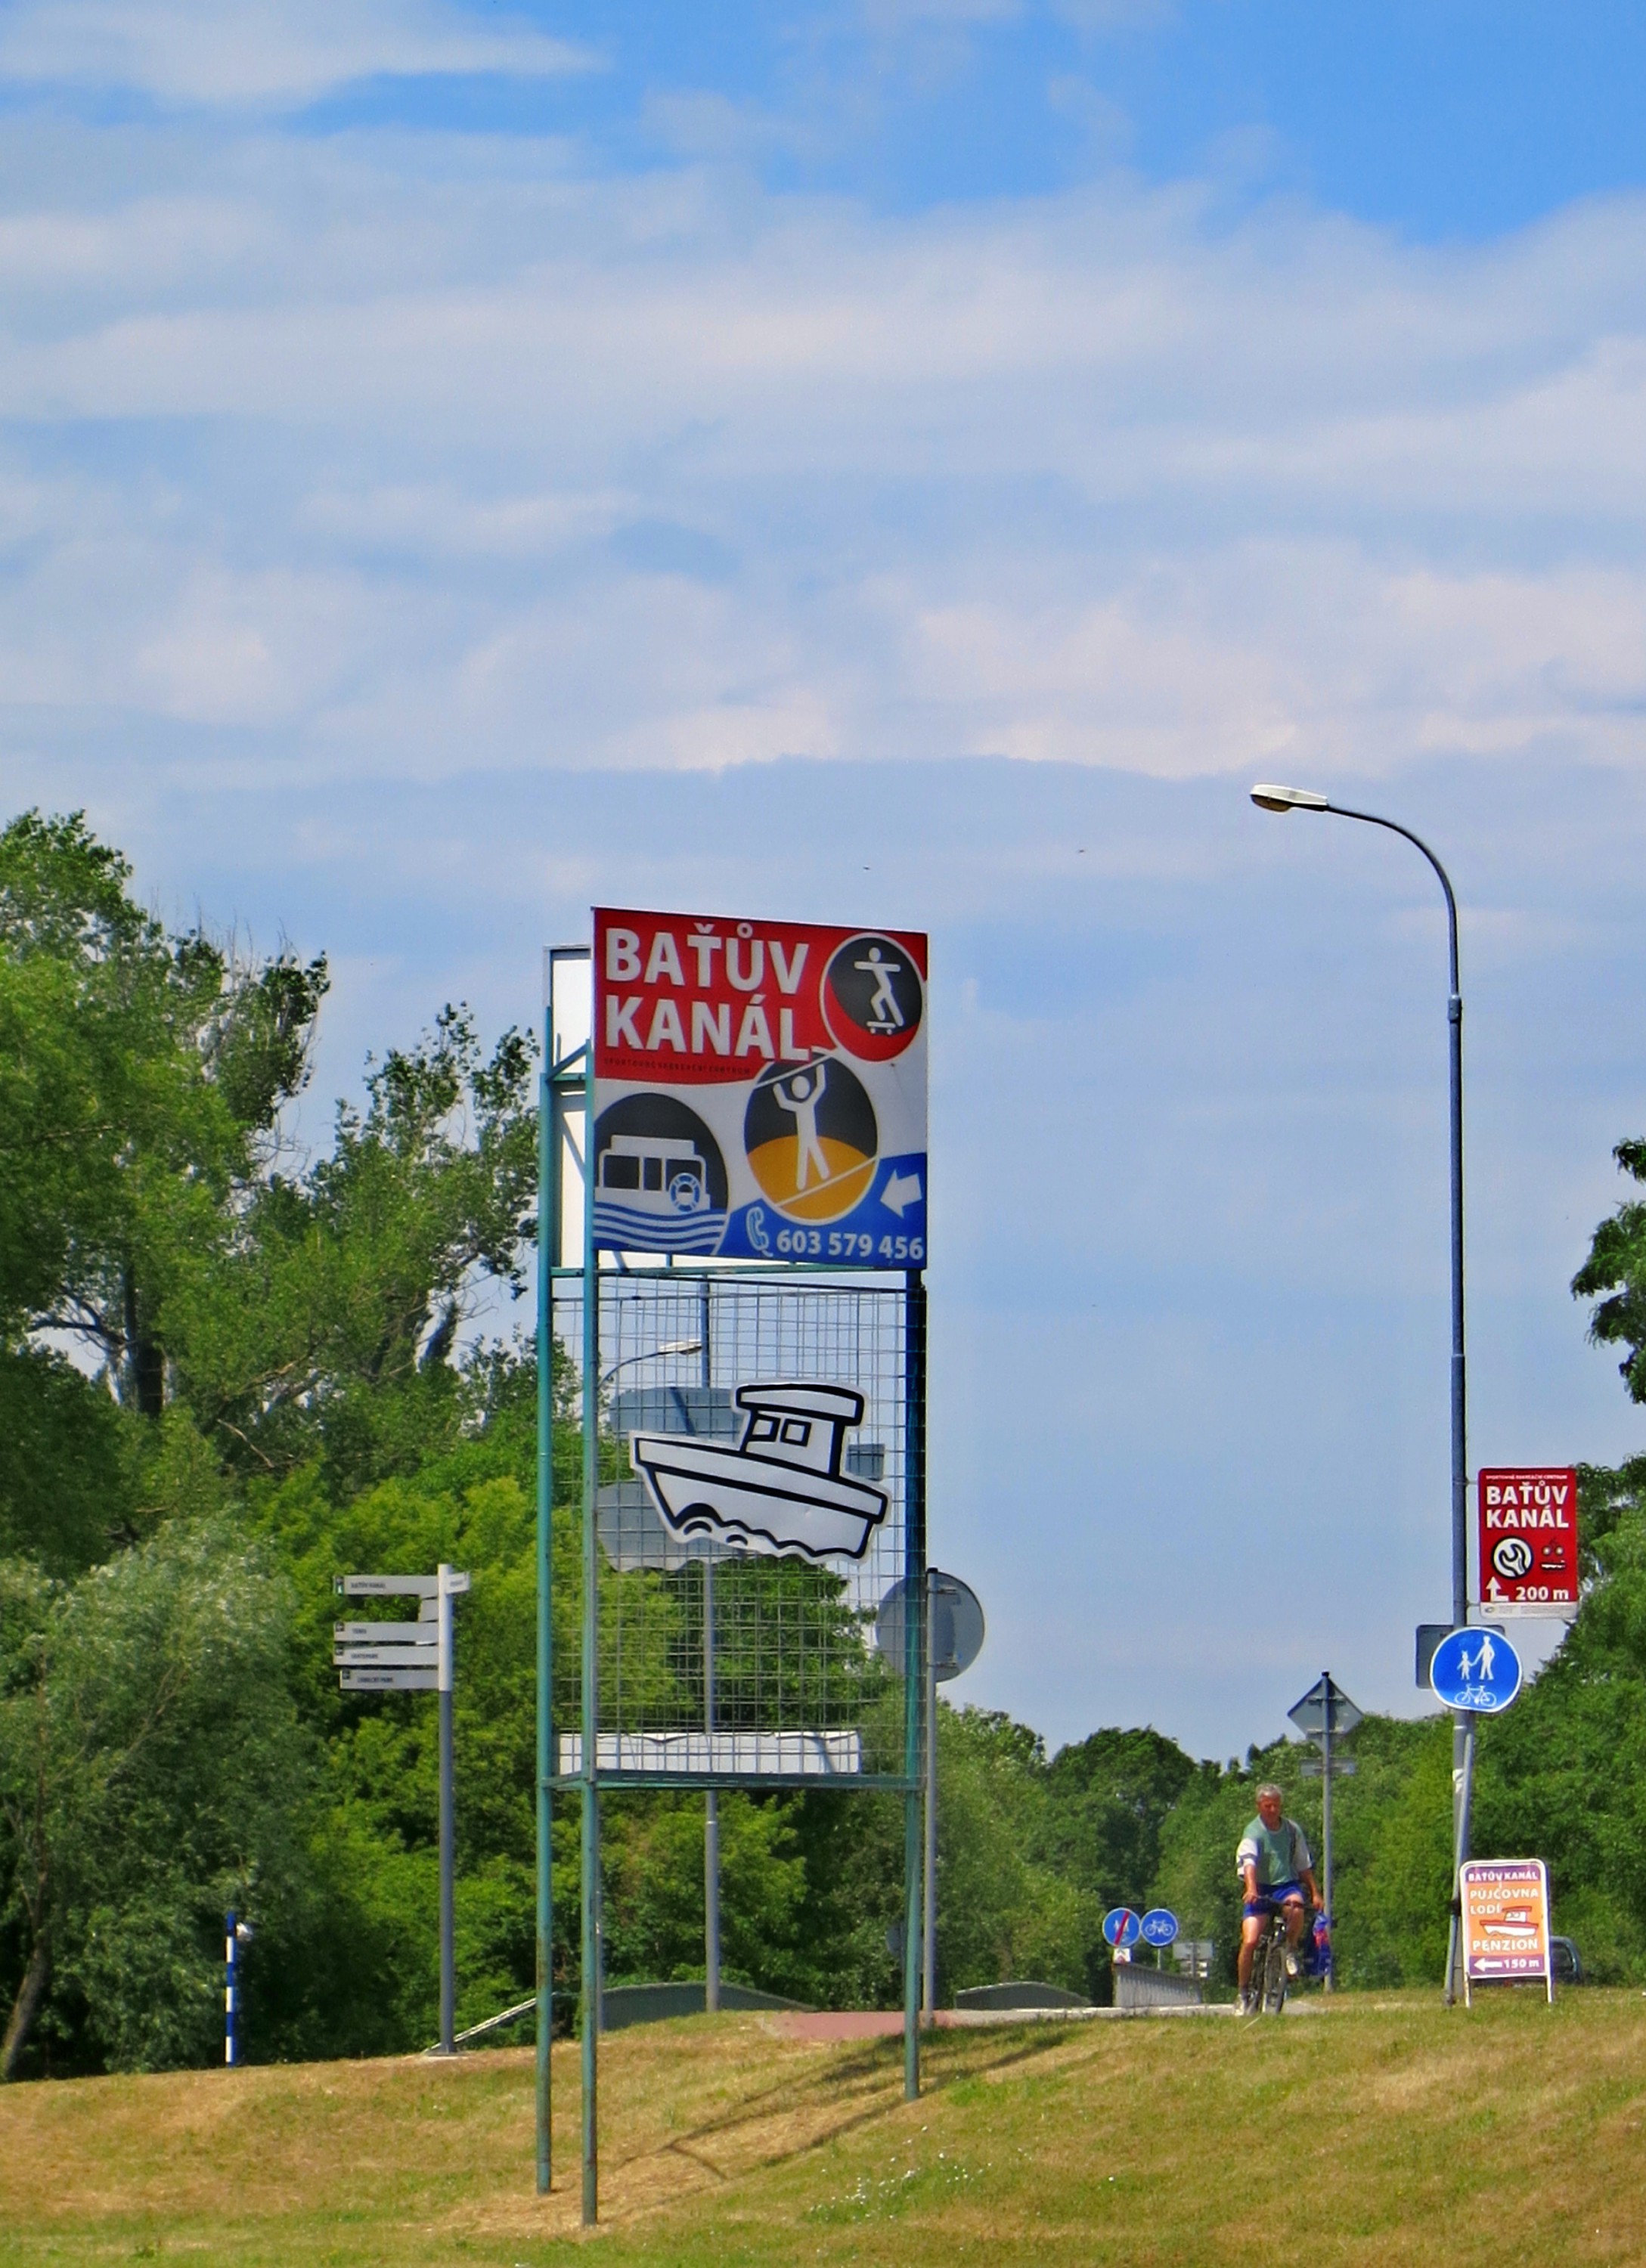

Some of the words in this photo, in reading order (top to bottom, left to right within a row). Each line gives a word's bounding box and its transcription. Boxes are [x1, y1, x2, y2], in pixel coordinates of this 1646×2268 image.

[606, 923, 810, 995] BAŤŮV
[606, 994, 810, 1061] KANÁL
[777, 1229, 821, 1254] 603
[828, 1232, 873, 1257] 579
[878, 1235, 924, 1260] 456
[1486, 1480, 1568, 1504] BAŤŮV
[1486, 1505, 1569, 1528] KANÁL
[1515, 1586, 1548, 1600] 200
[1552, 1588, 1569, 1600] m
[1504, 1870, 1538, 1880] KANÁL
[1472, 1938, 1538, 1950] PENZION
[1504, 1958, 1527, 1969] 150
[1529, 1960, 1539, 1968] m
